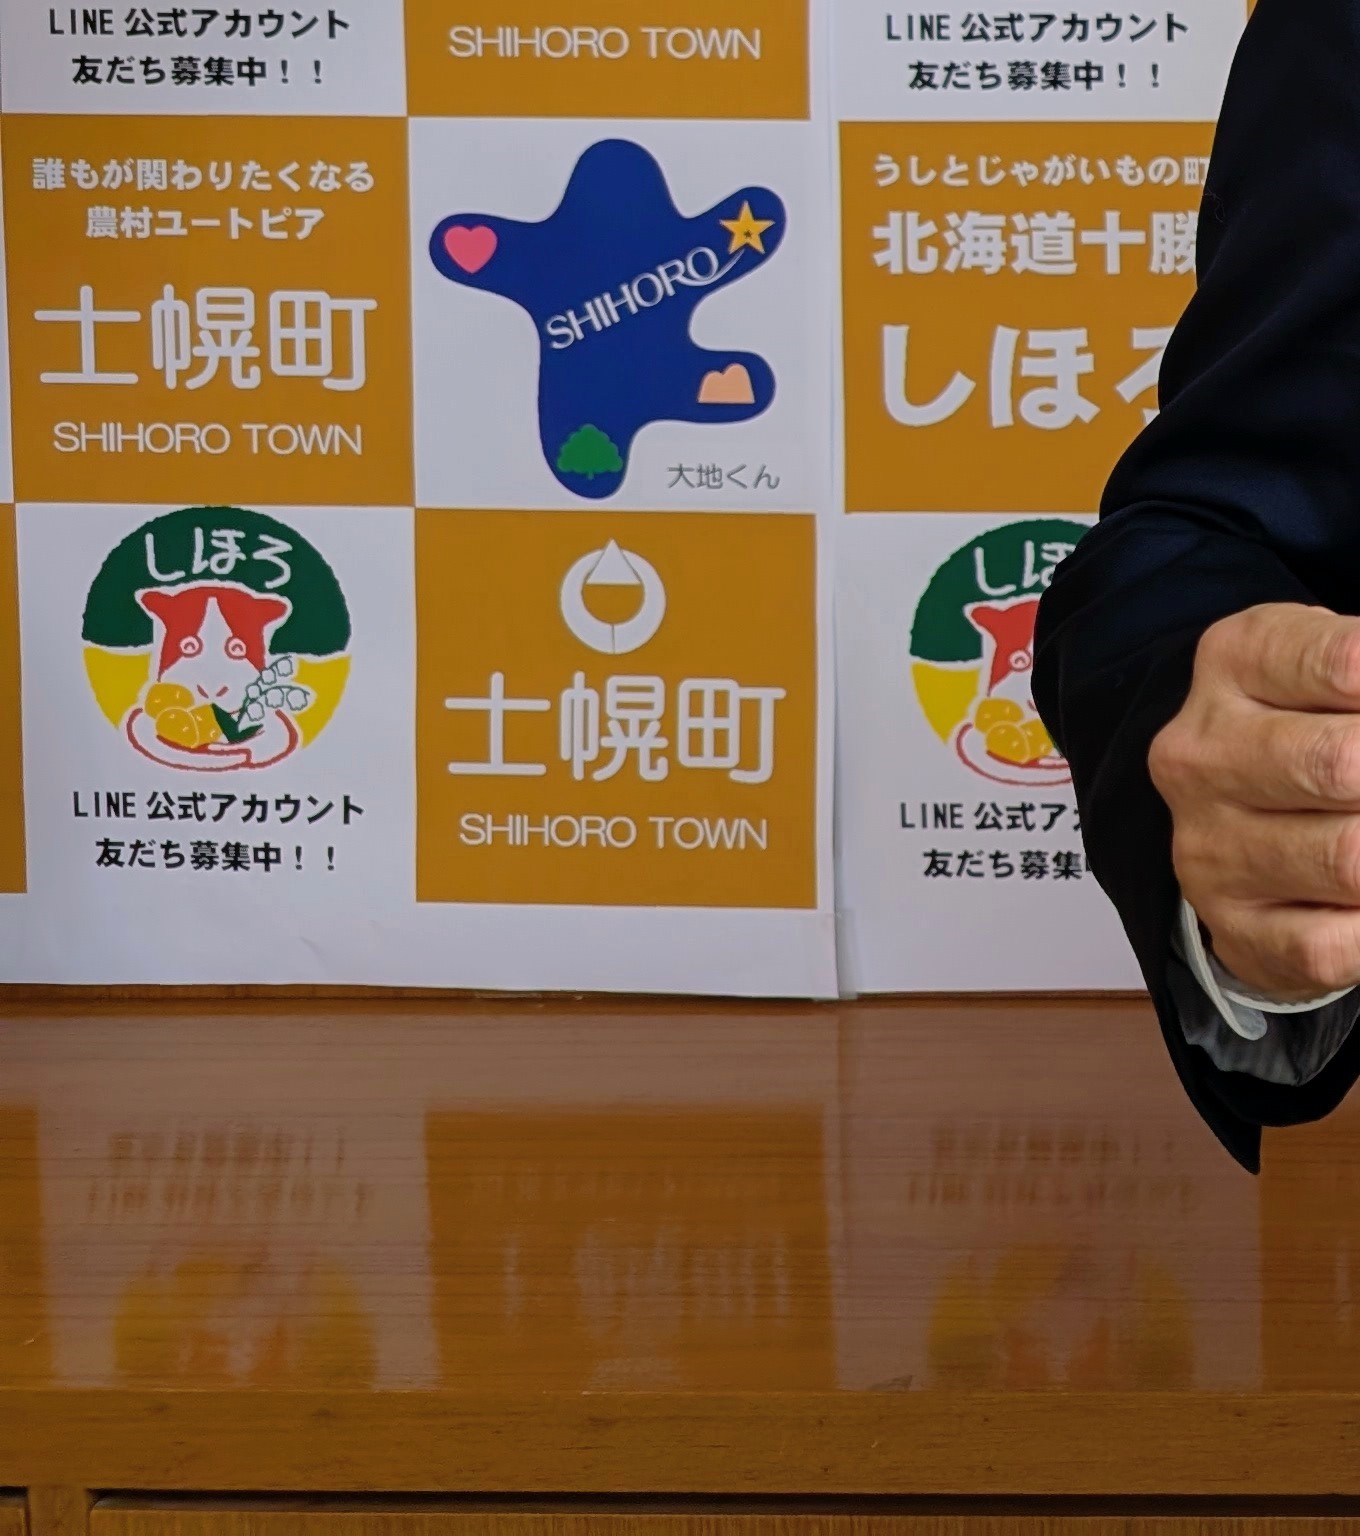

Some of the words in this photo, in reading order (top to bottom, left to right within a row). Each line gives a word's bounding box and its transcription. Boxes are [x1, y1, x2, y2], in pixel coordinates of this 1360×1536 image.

[50, 9, 113, 34] LINE
[125, 8, 348, 38] 公式アカウント
[887, 15, 950, 40] LINE
[962, 13, 1187, 41] 公式アカウント
[449, 26, 629, 58] SHIHORO
[641, 27, 760, 59] TOWN
[72, 55, 320, 85] 友だち募集中！！
[909, 61, 1158, 90] 友だち募集中！！
[32, 158, 374, 192] 誰もが関わりたくなる
[872, 152, 1206, 188] うしとじゃがいもの町
[86, 206, 324, 239] 農村ユートピア
[870, 208, 1198, 278] 北海道十勝
[546, 246, 719, 352] SHIHORO
[34, 284, 377, 391] 士幌町
[54, 422, 230, 454] SHIHORO
[242, 424, 361, 455] TOWN
[669, 464, 780, 489] 大地くん
[145, 526, 294, 589] しほろ
[974, 540, 1077, 599] しほ
[445, 671, 786, 783] 士幌町
[74, 792, 135, 817] LINE
[147, 792, 363, 824] 公式アカウント
[901, 803, 963, 828] LINE
[460, 814, 636, 848] SHIHORO
[649, 817, 767, 849] TOWN
[96, 838, 333, 871] 友だち募集中！！
[922, 848, 1094, 882] 友だち募集
